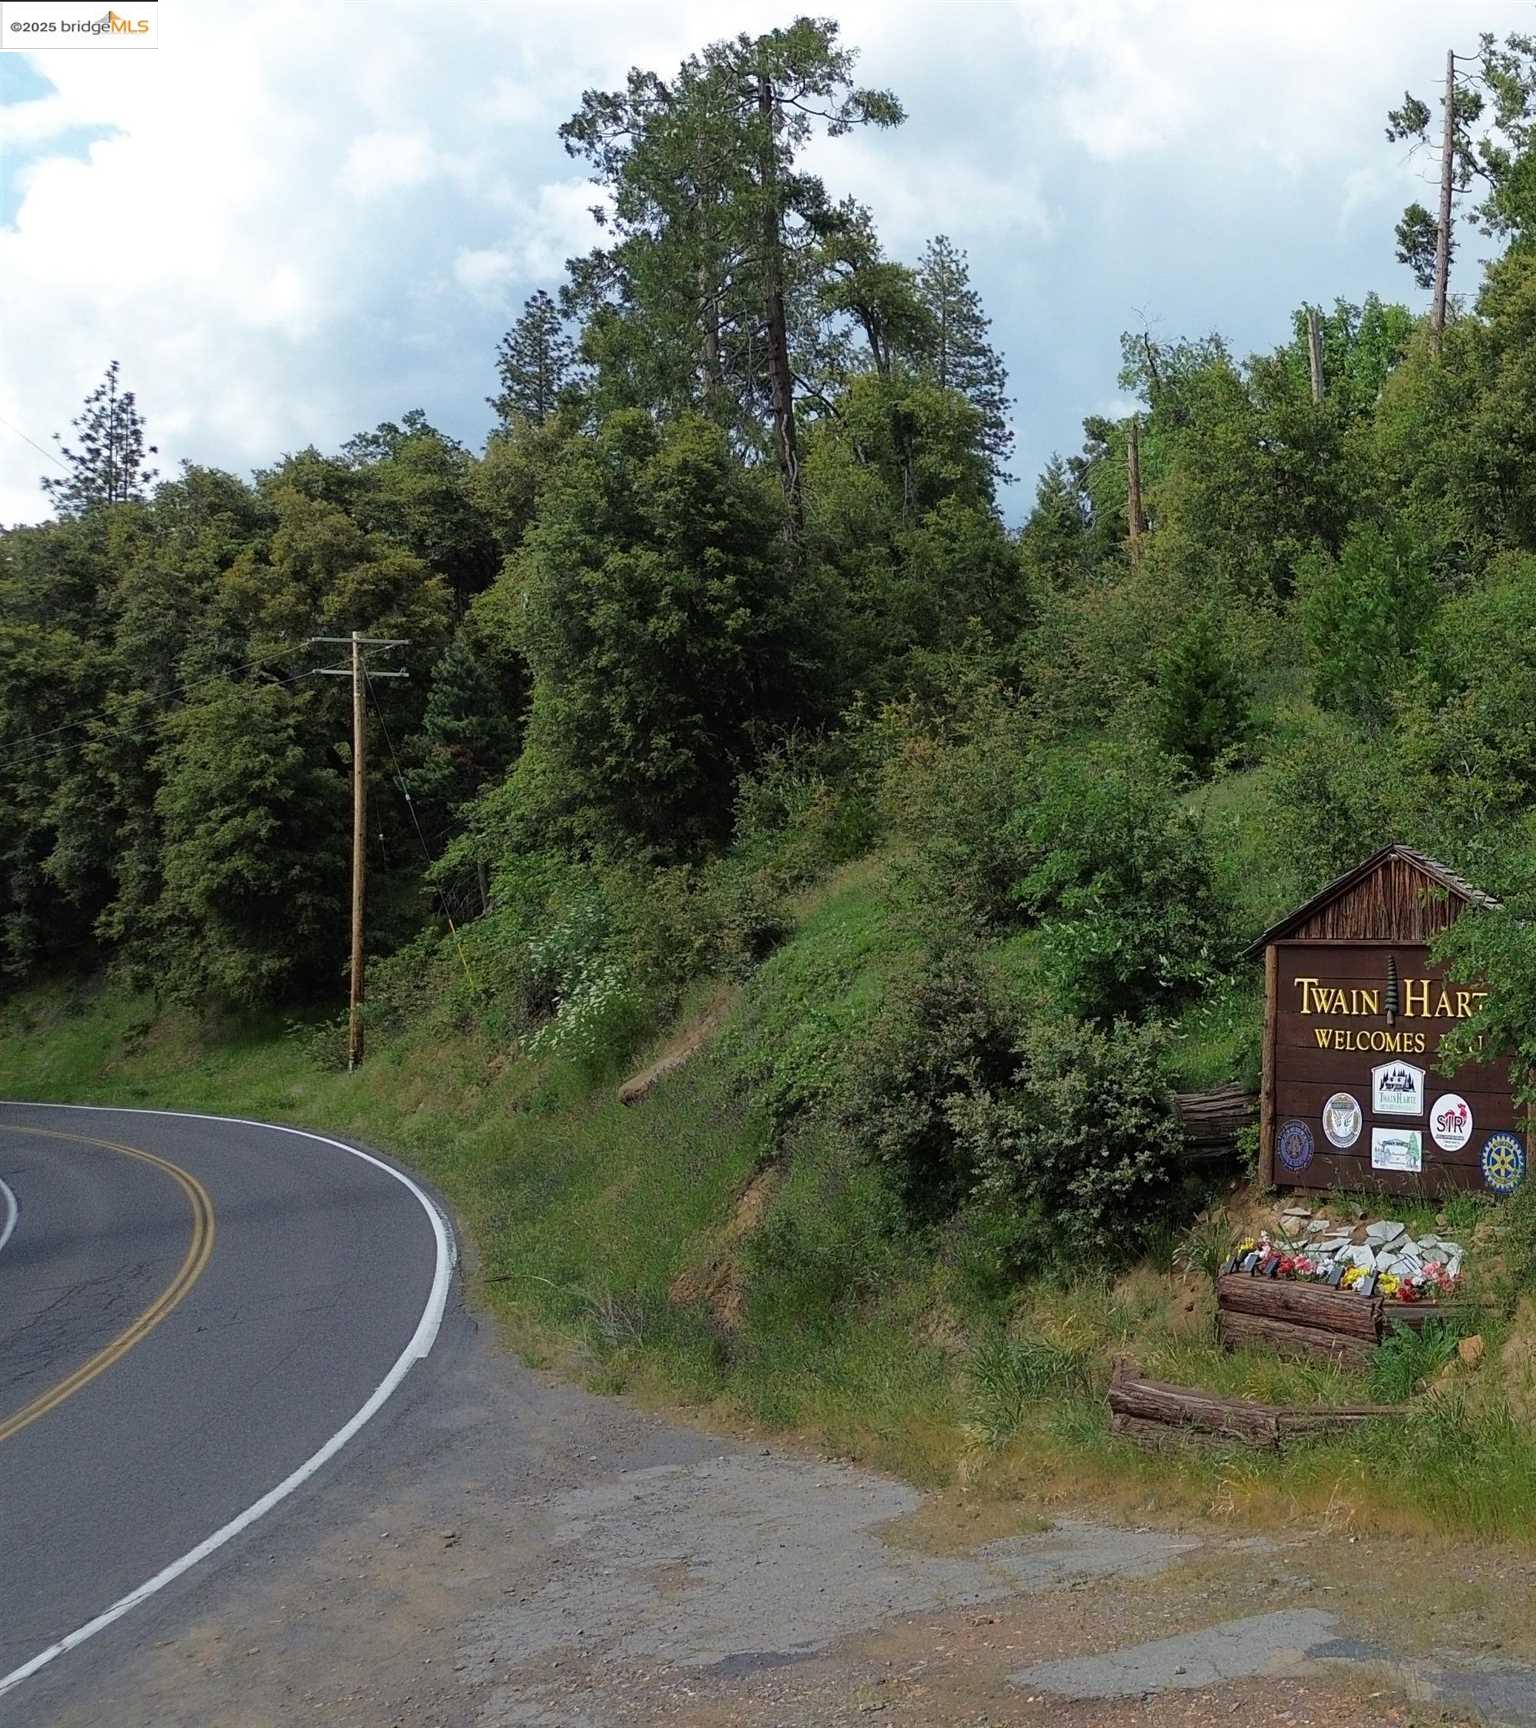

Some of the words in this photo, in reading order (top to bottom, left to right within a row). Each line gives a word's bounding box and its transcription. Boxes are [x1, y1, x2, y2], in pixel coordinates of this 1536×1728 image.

[1294, 978, 1379, 1015] TWAIN
[1404, 979, 1488, 1018] HART
[1314, 1028, 1425, 1053] WELCOMES
[1437, 1114, 1463, 1133] SIR
